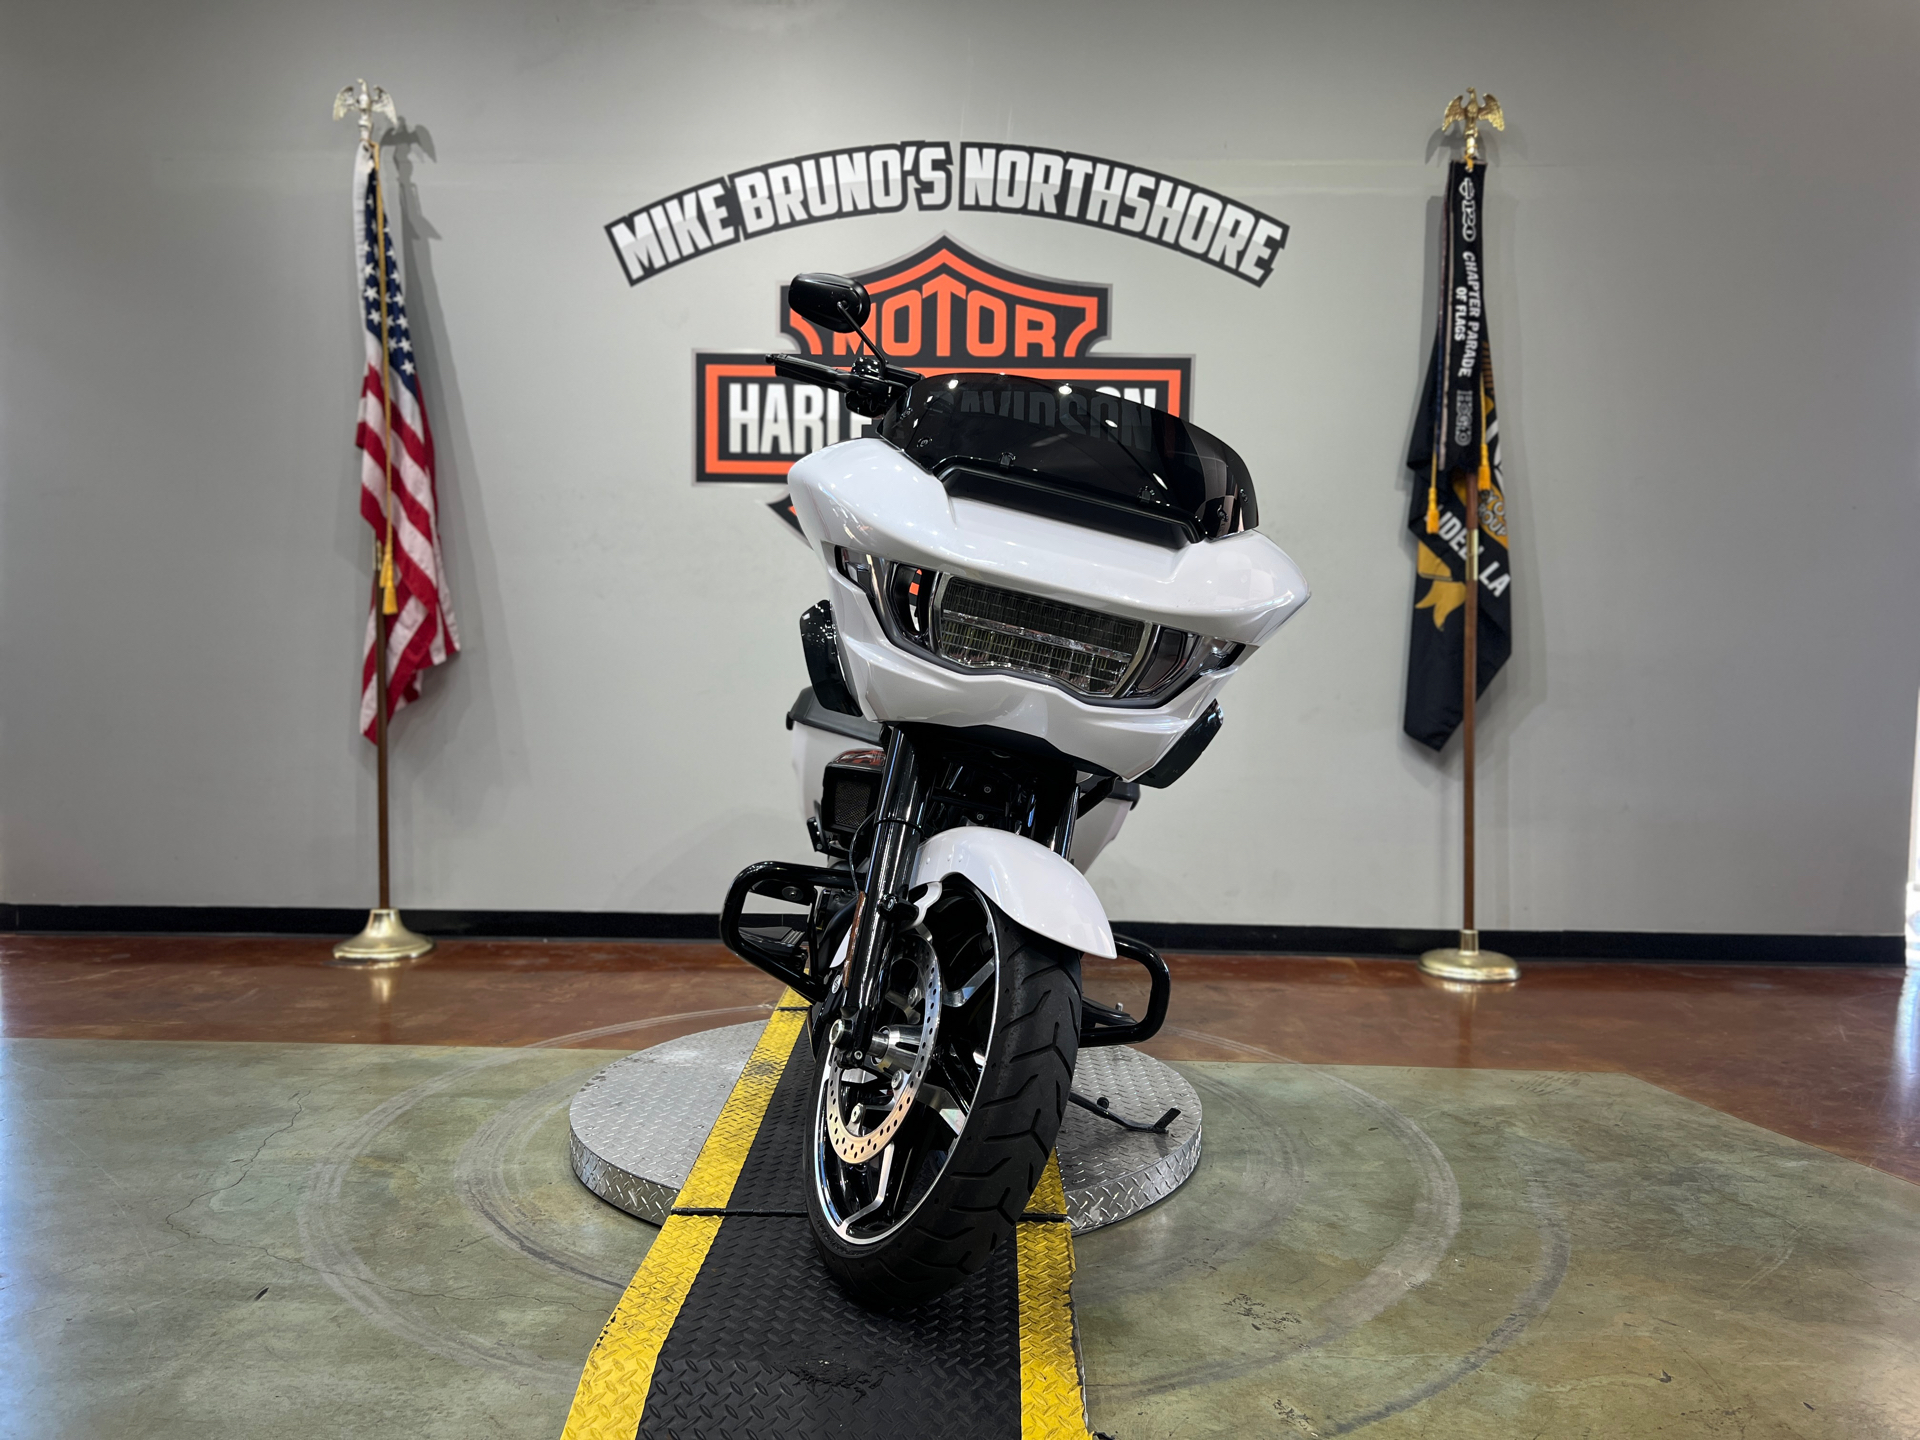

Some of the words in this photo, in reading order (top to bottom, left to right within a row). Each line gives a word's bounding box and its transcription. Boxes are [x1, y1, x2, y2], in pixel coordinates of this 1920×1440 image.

[611, 182, 736, 279] MIKE
[734, 146, 948, 234] BRUNO'S
[965, 146, 1284, 282] NORTHSHORE
[1456, 287, 1467, 303] OF
[1463, 252, 1479, 316] CHAPTER
[1454, 305, 1467, 341] FLAGS
[1458, 321, 1479, 376] PARADE
[1479, 561, 1511, 597] LA
